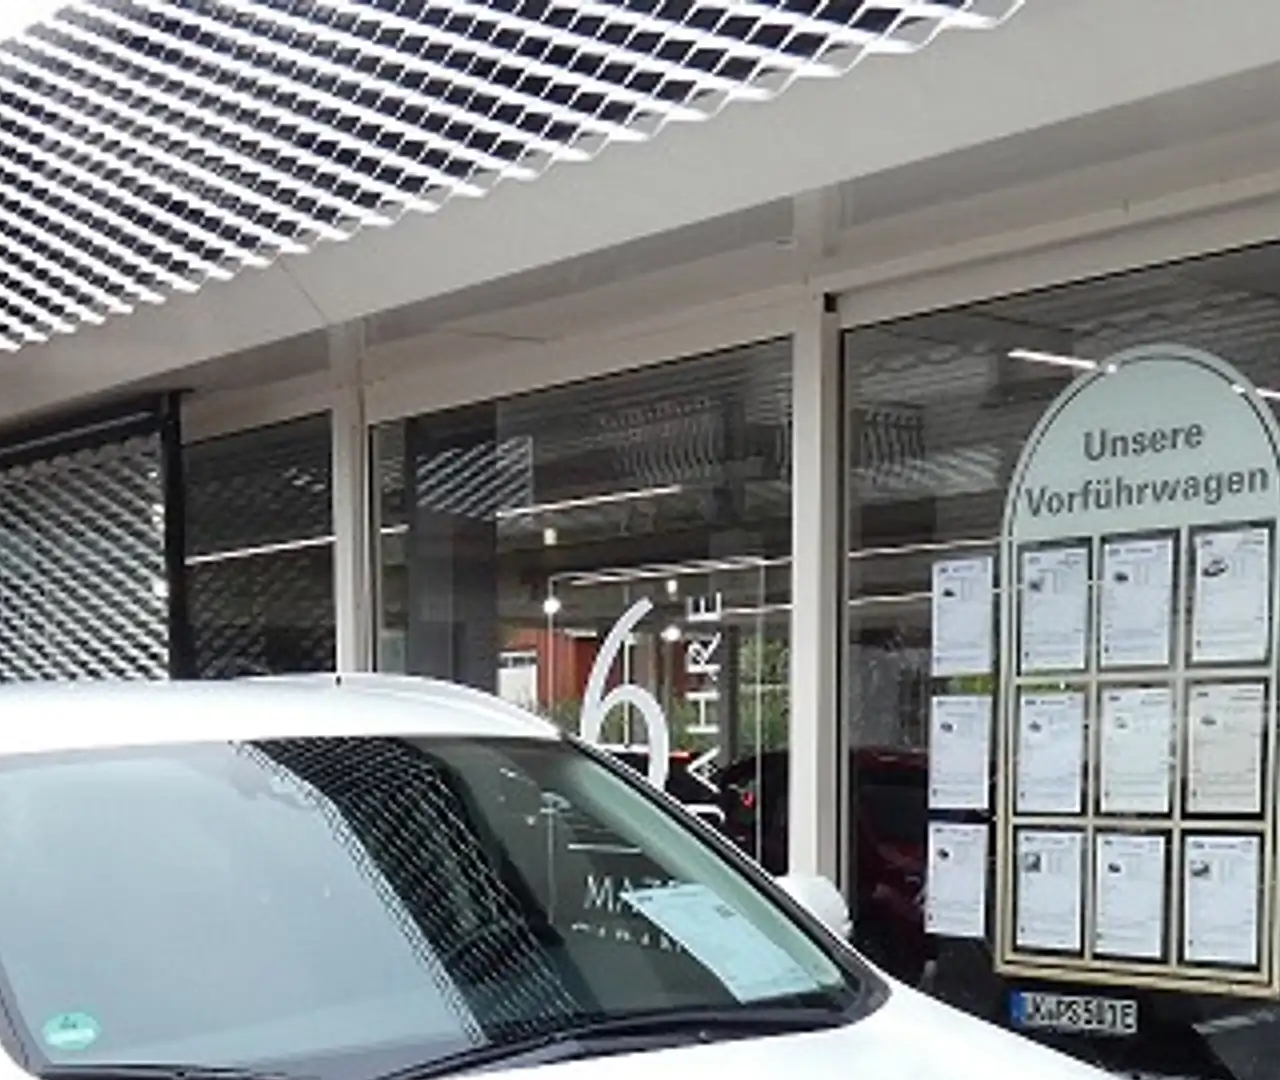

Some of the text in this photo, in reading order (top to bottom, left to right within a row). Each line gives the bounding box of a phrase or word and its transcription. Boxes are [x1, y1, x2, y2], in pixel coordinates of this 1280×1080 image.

[1083, 423, 1206, 462] Unsere
[1025, 466, 1269, 518] Vorführwagen
[685, 591, 725, 823] JAHRE
